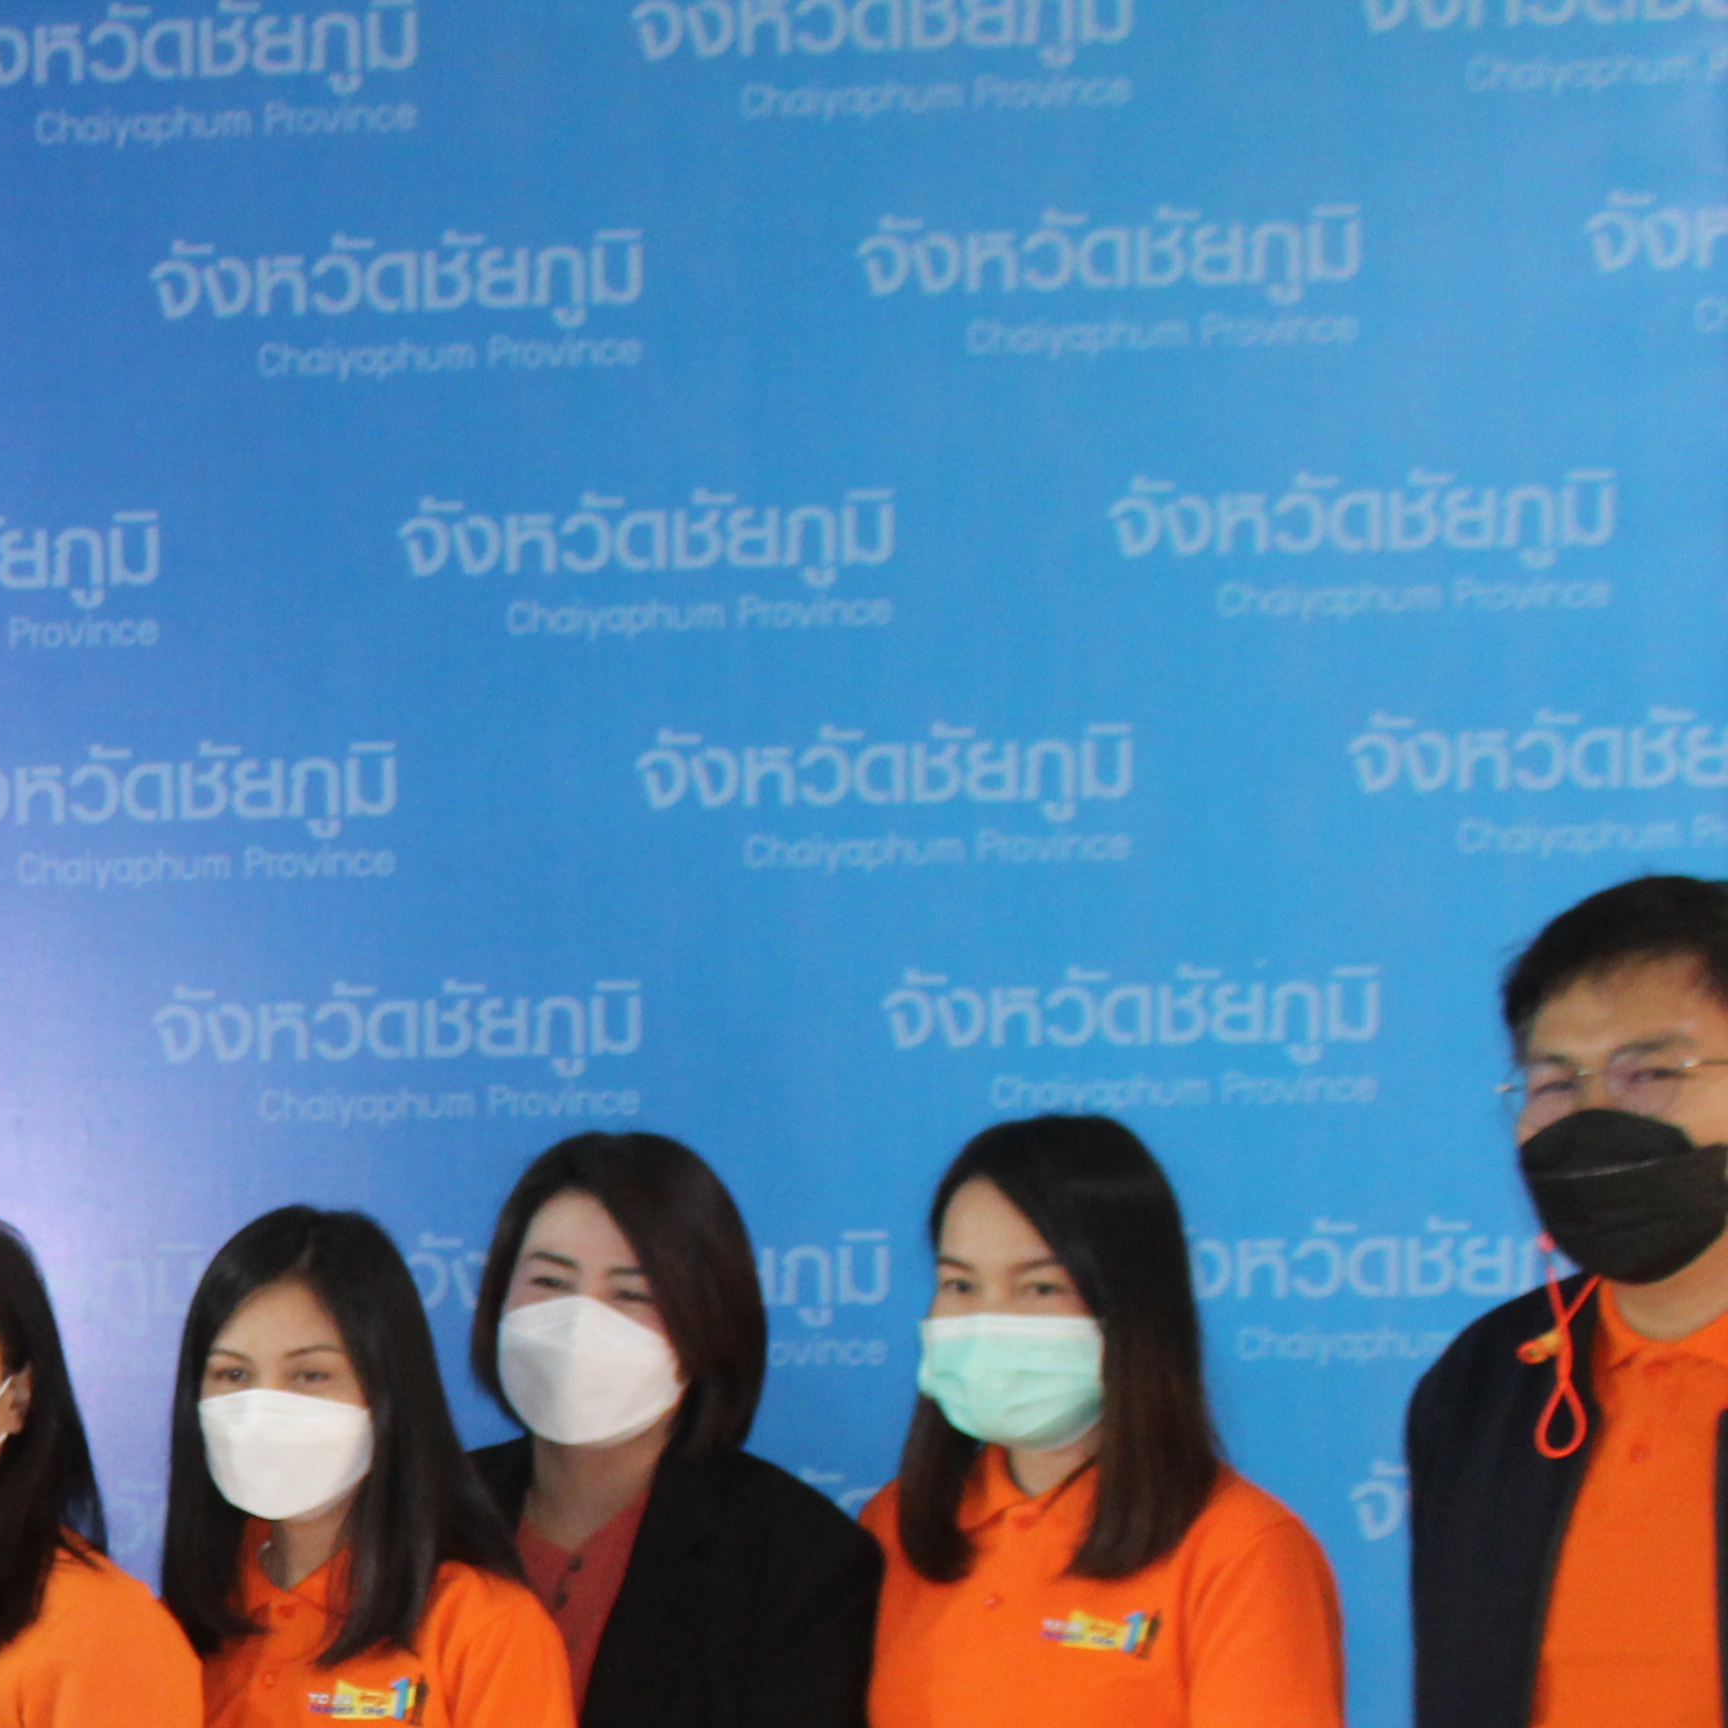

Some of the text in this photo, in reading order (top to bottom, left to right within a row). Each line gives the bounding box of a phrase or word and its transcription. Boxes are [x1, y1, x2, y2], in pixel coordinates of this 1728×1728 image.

[150, 229, 645, 328] จังหวัดชัยภูมิ
[857, 205, 1364, 305] จังหวัดชัยภูมิ
[398, 486, 896, 588] จังหวัดชัยภูมิ
[1107, 469, 1617, 568] จังหวัดชัยภูมิ
[635, 723, 1135, 822] จังหวัดชัยภูมิ
[1348, 706, 1728, 794] จังหวัดชัย
[152, 979, 643, 1079] จังหวัดชัยภูมิ
[882, 964, 1382, 1064] จังหวัดชัยภูมิ
